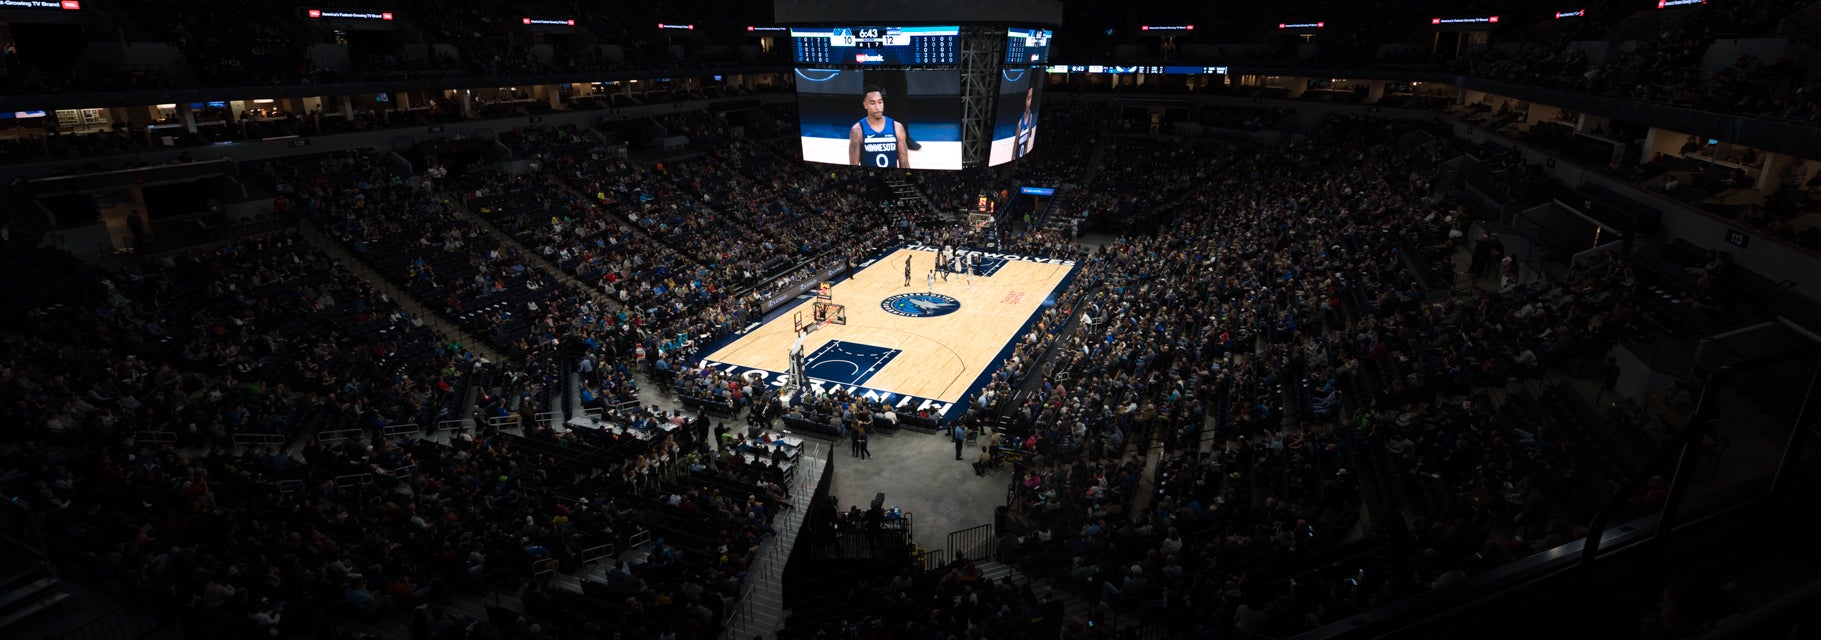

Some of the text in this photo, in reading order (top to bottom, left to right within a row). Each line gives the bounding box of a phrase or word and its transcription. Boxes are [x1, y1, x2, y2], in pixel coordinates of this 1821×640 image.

[859, 28, 878, 38] 6:43
[844, 36, 853, 44] 10
[885, 36, 894, 45] 12
[864, 143, 896, 151] MINNESOTA
[876, 153, 888, 168] 0
